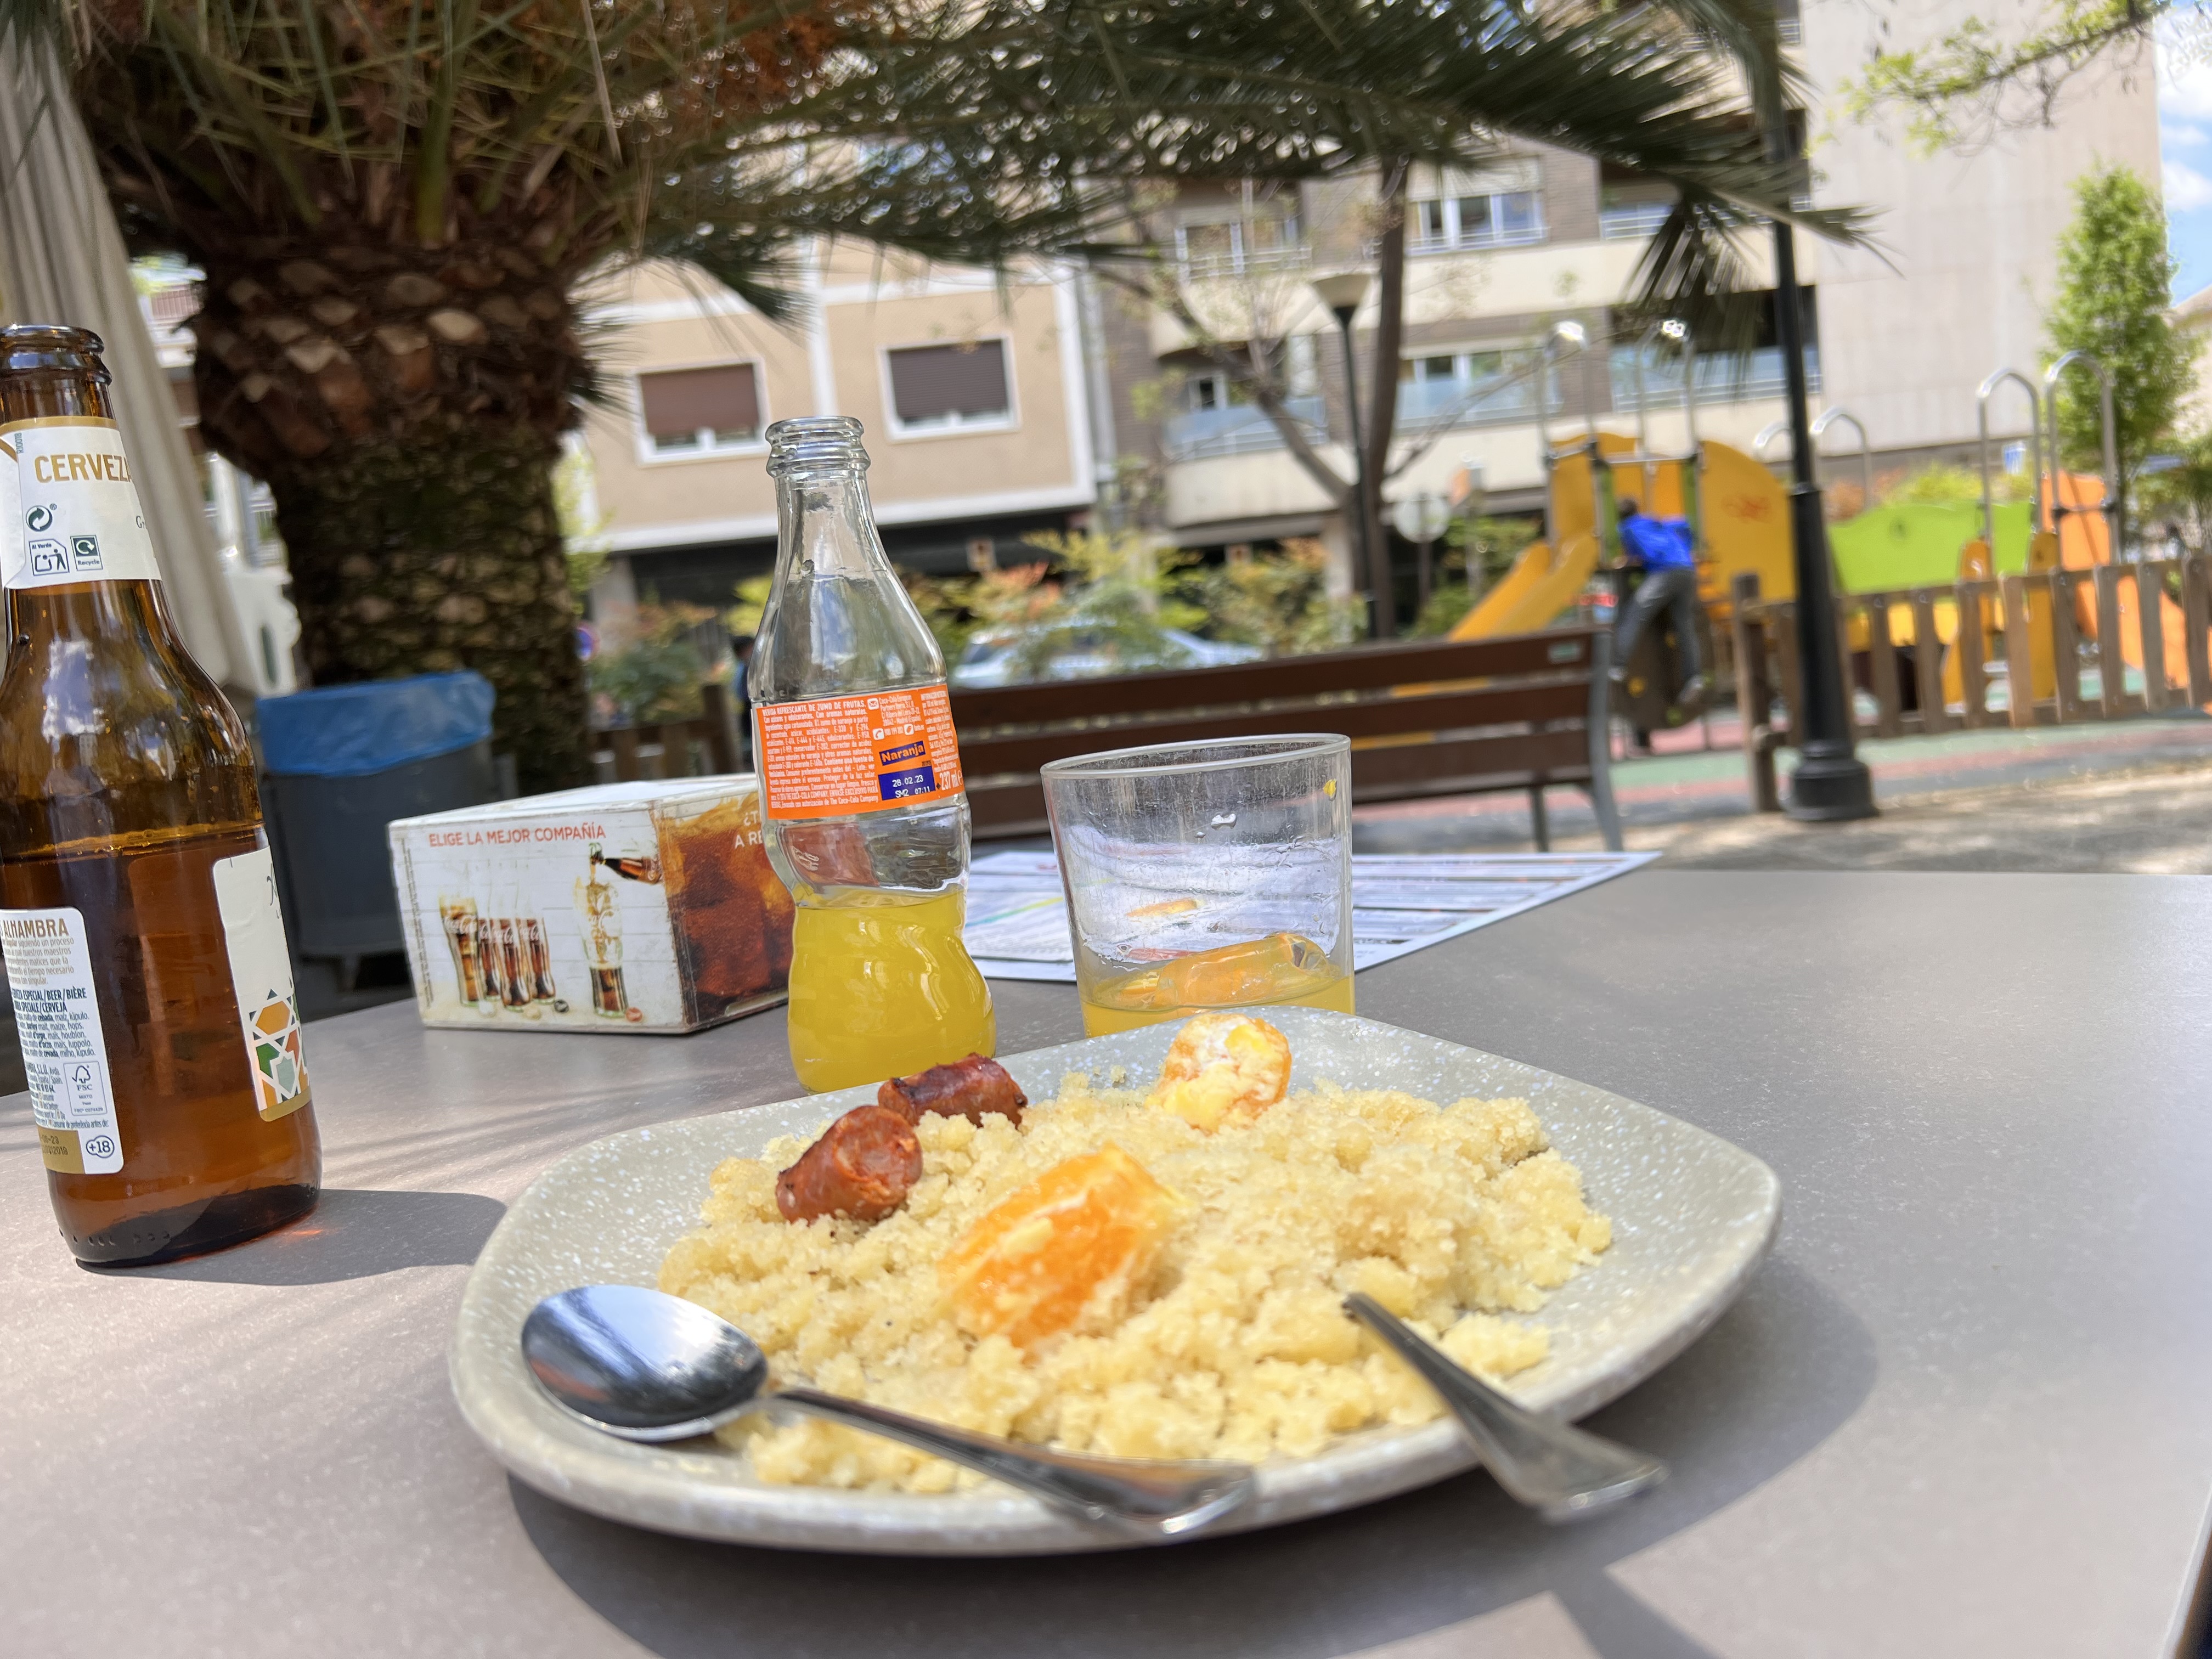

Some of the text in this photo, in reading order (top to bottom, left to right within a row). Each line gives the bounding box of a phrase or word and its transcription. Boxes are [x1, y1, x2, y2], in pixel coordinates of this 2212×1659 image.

[777, 705, 808, 715] REFRESCANTE
[808, 703, 816, 712] DE
[817, 702, 832, 711] ZUMO
[834, 702, 842, 710] DE
[843, 700, 867, 709] FRUTAS.
[882, 743, 924, 763] Naranja
[824, 758, 844, 766] Contiene
[891, 775, 924, 787] 28.02.23
[939, 771, 951, 791] 237
[951, 769, 959, 788] ml
[915, 786, 930, 795] 07:11
[838, 795, 859, 804] Coca-Cola
[429, 822, 606, 847] ELIGE LA MEJOR COMPAÑÍA
[735, 834, 745, 849] A
[50, 938, 75, 949] proceso
[44, 947, 71, 956] maestros
[29, 957, 49, 966] matices
[49, 958, 61, 968] que
[63, 956, 69, 965] la
[27, 966, 46, 978] tiempo
[46, 965, 75, 975] necesario
[66, 986, 87, 999] BIÈRE
[42, 1001, 67, 1013] CERVEJA
[67, 1022, 84, 1031] hops.
